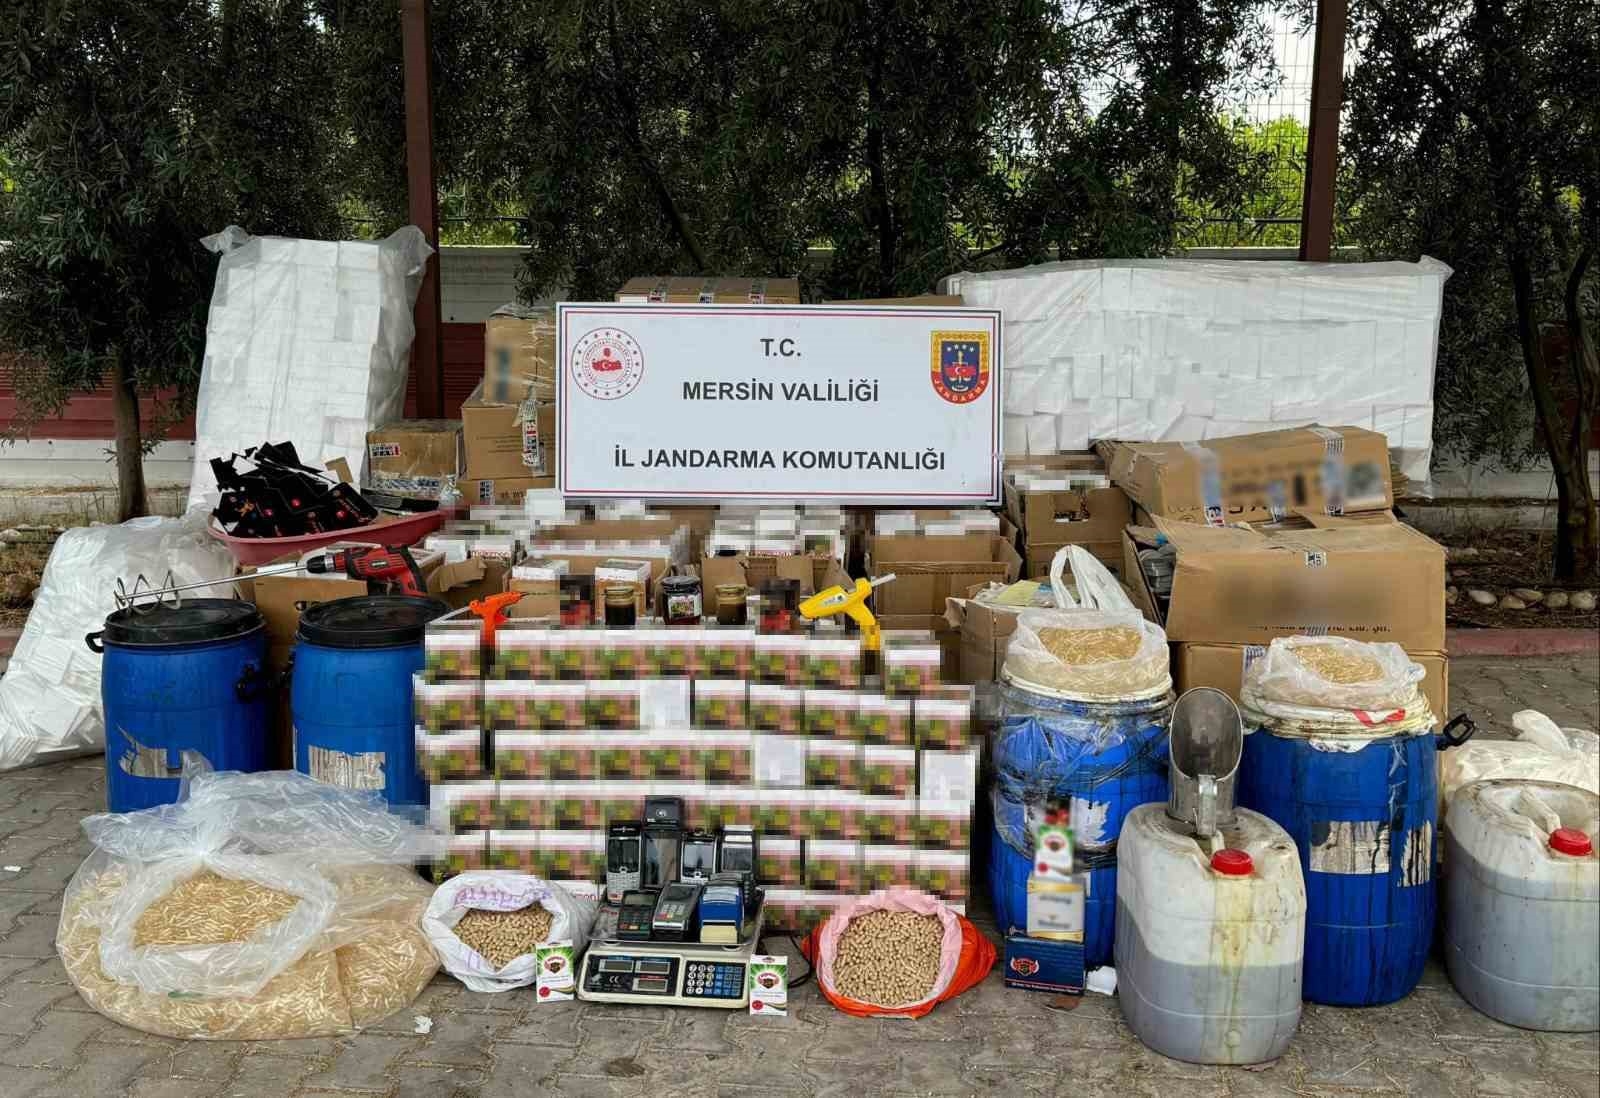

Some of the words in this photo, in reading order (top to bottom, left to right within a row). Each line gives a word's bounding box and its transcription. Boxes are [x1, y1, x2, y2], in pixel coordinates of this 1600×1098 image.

[759, 338, 802, 357] T.C.
[683, 377, 773, 401] MERSİN
[780, 378, 879, 402] VALİLİĞİ
[933, 378, 987, 402] JANDARMA
[615, 444, 635, 467] İL
[640, 448, 776, 469] JANDARMA
[782, 446, 945, 471] KOMUTANLIĞI
